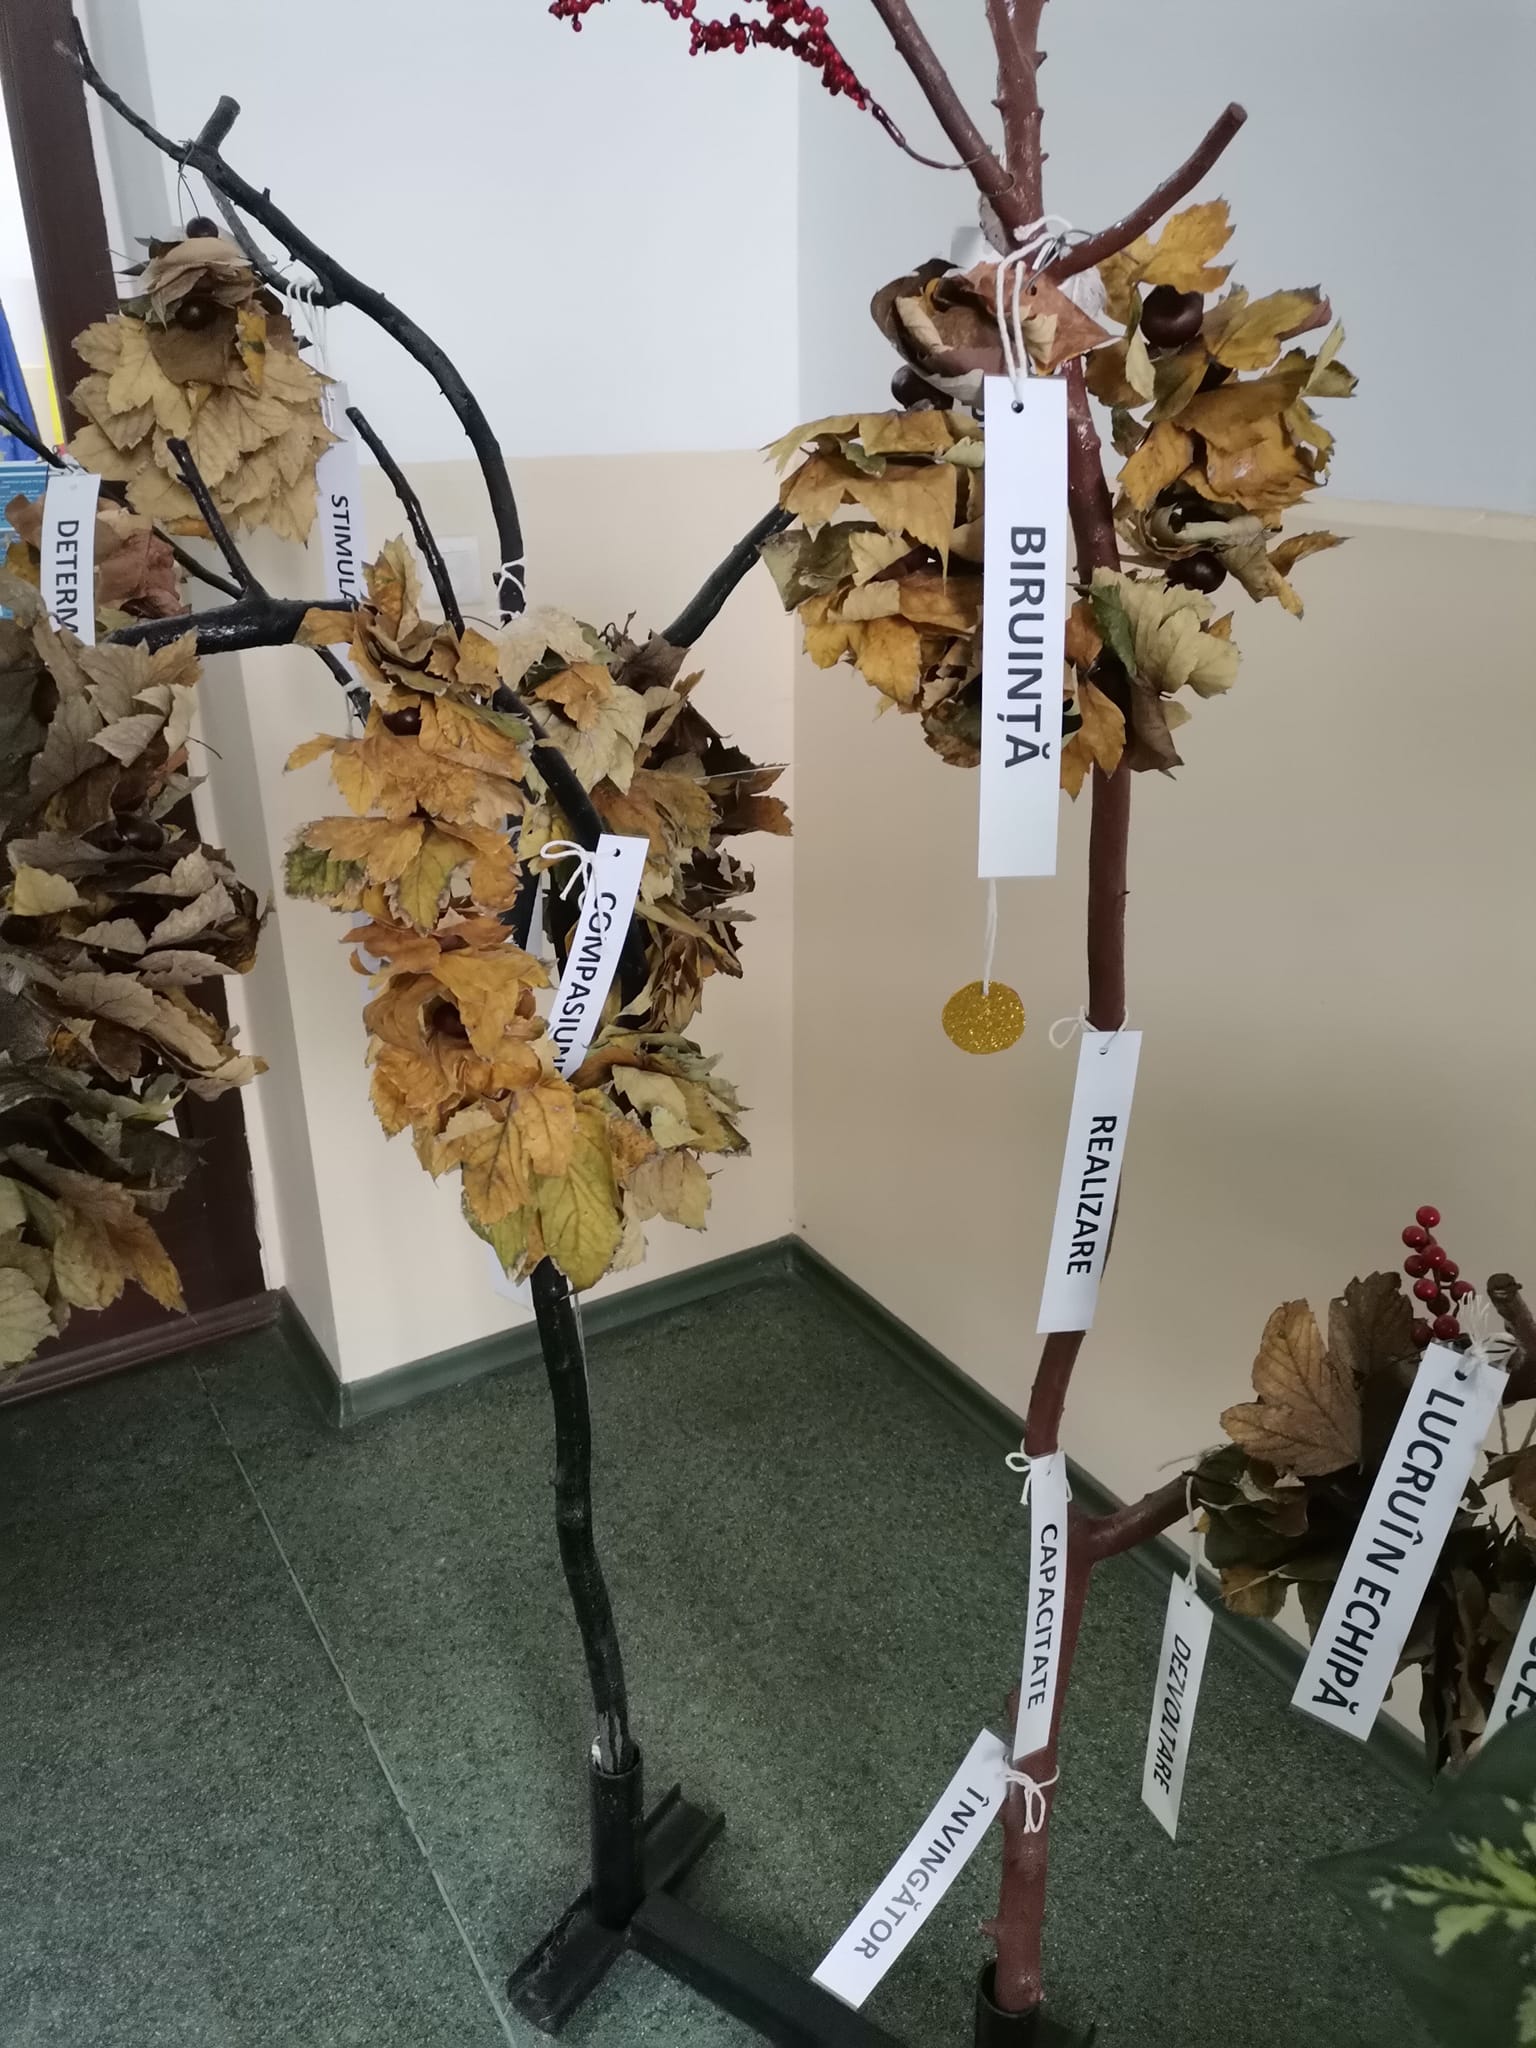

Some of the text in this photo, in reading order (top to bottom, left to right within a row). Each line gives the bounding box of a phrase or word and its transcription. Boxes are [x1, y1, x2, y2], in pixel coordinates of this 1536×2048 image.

[997, 526, 1050, 768] BIRUINȚĂ
[553, 892, 617, 1073] COMPASIUN
[1066, 1115, 1118, 1275] REALIZARE
[1027, 1523, 1058, 1710] CAPACITATE
[1311, 1576, 1392, 1715] ECHIPĂ
[1153, 1633, 1192, 1795] DEZVOLTARE
[853, 1786, 990, 1960] ÎNVINGĂTOR
